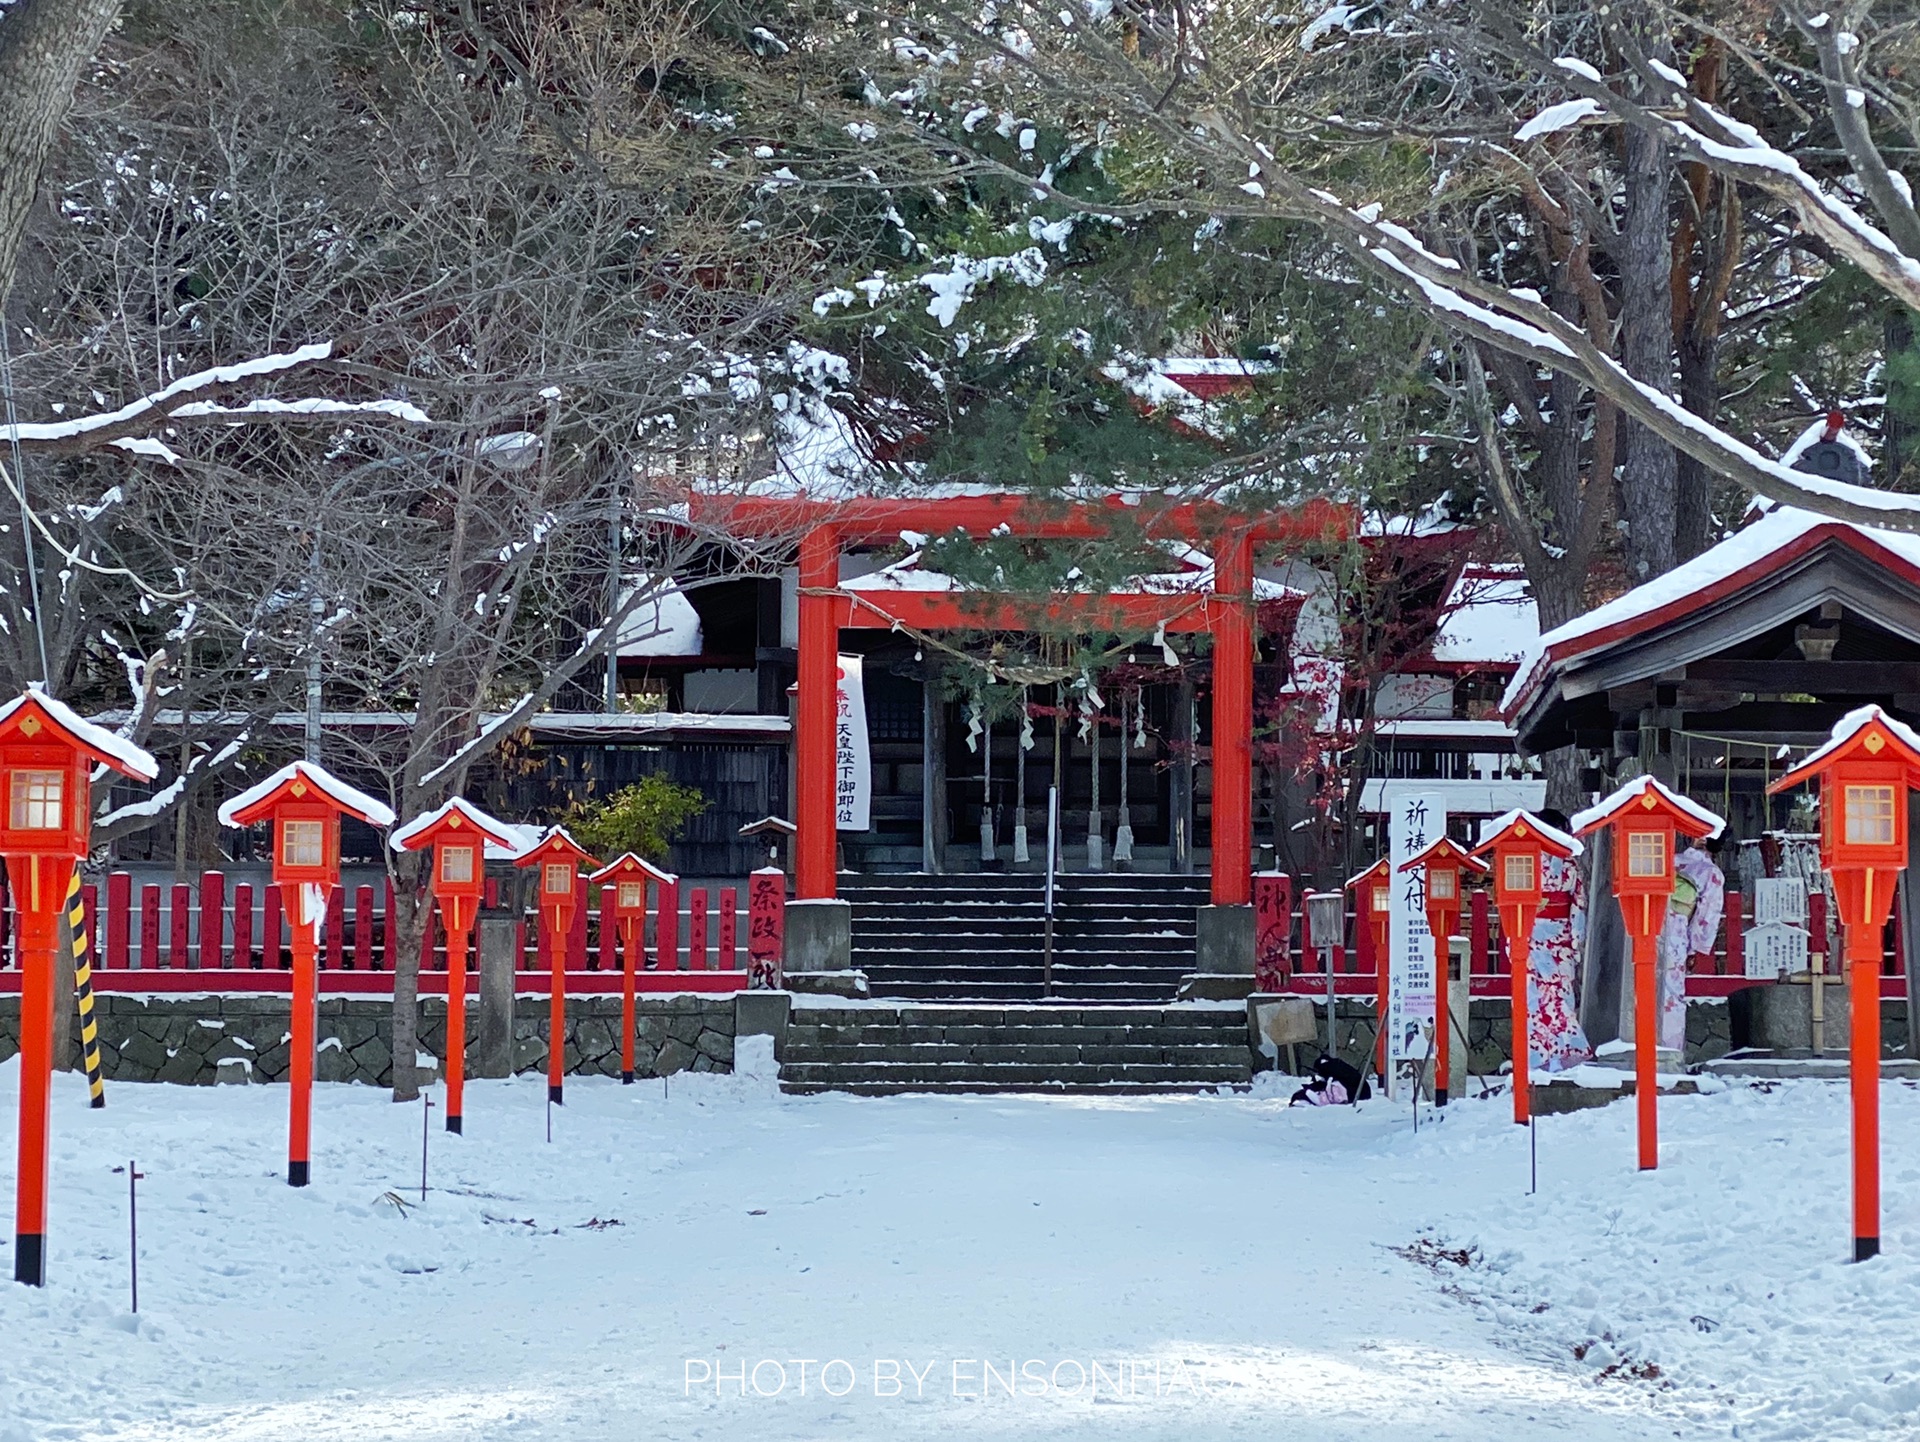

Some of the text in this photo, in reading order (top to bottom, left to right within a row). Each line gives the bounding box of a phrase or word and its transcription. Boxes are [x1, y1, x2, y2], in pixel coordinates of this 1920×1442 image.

[837, 723, 856, 823] 天皇陛下御即位
[1392, 974, 1401, 1056] 伏見稲荷神社
